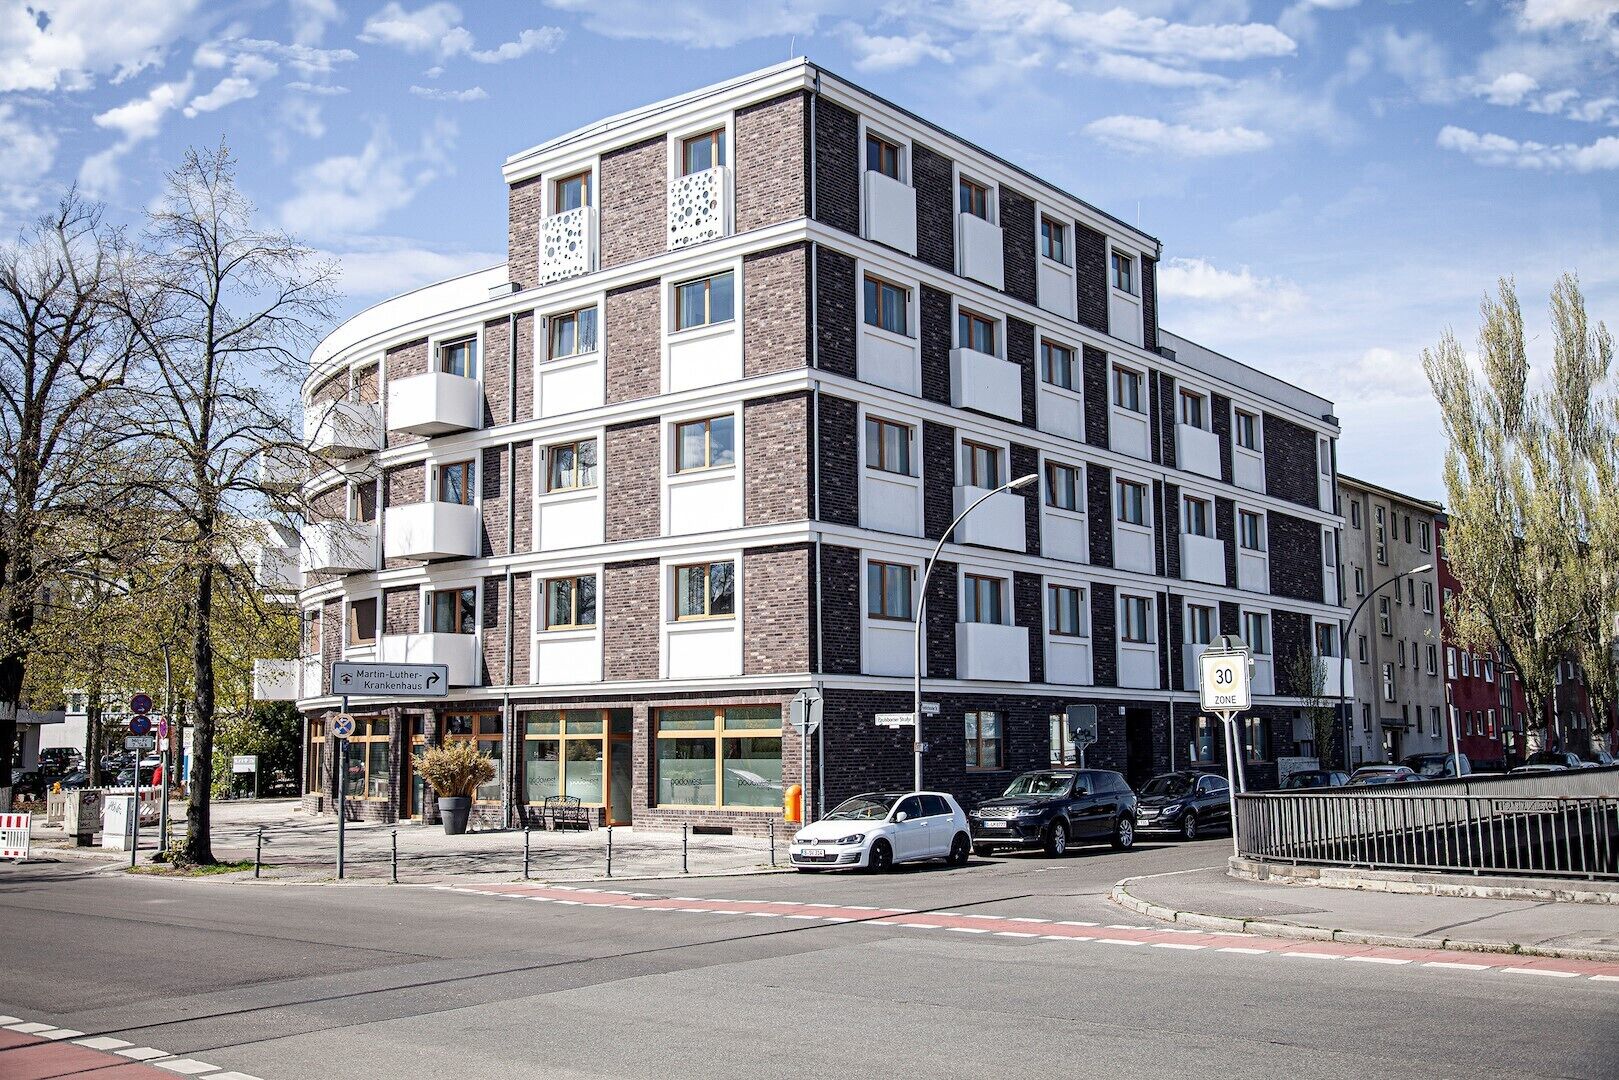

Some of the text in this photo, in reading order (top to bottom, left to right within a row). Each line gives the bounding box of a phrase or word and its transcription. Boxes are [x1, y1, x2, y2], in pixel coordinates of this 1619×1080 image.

[356, 670, 423, 679] Martin-Luther-
[1215, 668, 1233, 684] 30
[364, 680, 423, 690] Krankenhaus
[1214, 695, 1237, 705] ZONE
